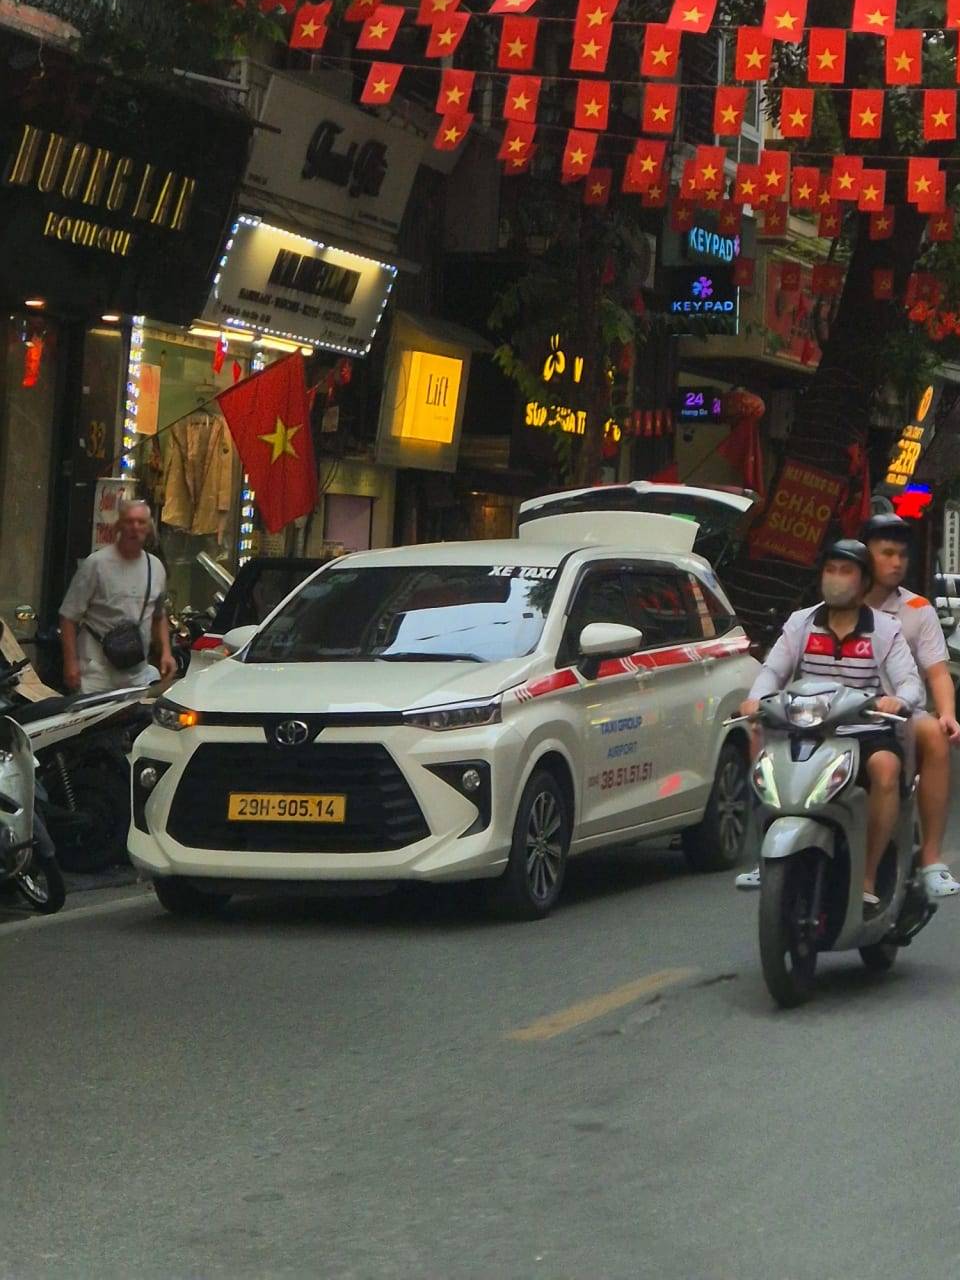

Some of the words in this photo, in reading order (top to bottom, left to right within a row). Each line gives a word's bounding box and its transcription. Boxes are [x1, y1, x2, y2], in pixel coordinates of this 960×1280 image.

[690, 226, 734, 262] KEYPAD
[672, 301, 734, 312] KEYPAD
[425, 373, 449, 408] Lift
[686, 392, 704, 406] 24
[488, 566, 515, 577] XE
[518, 567, 557, 580] TAXI
